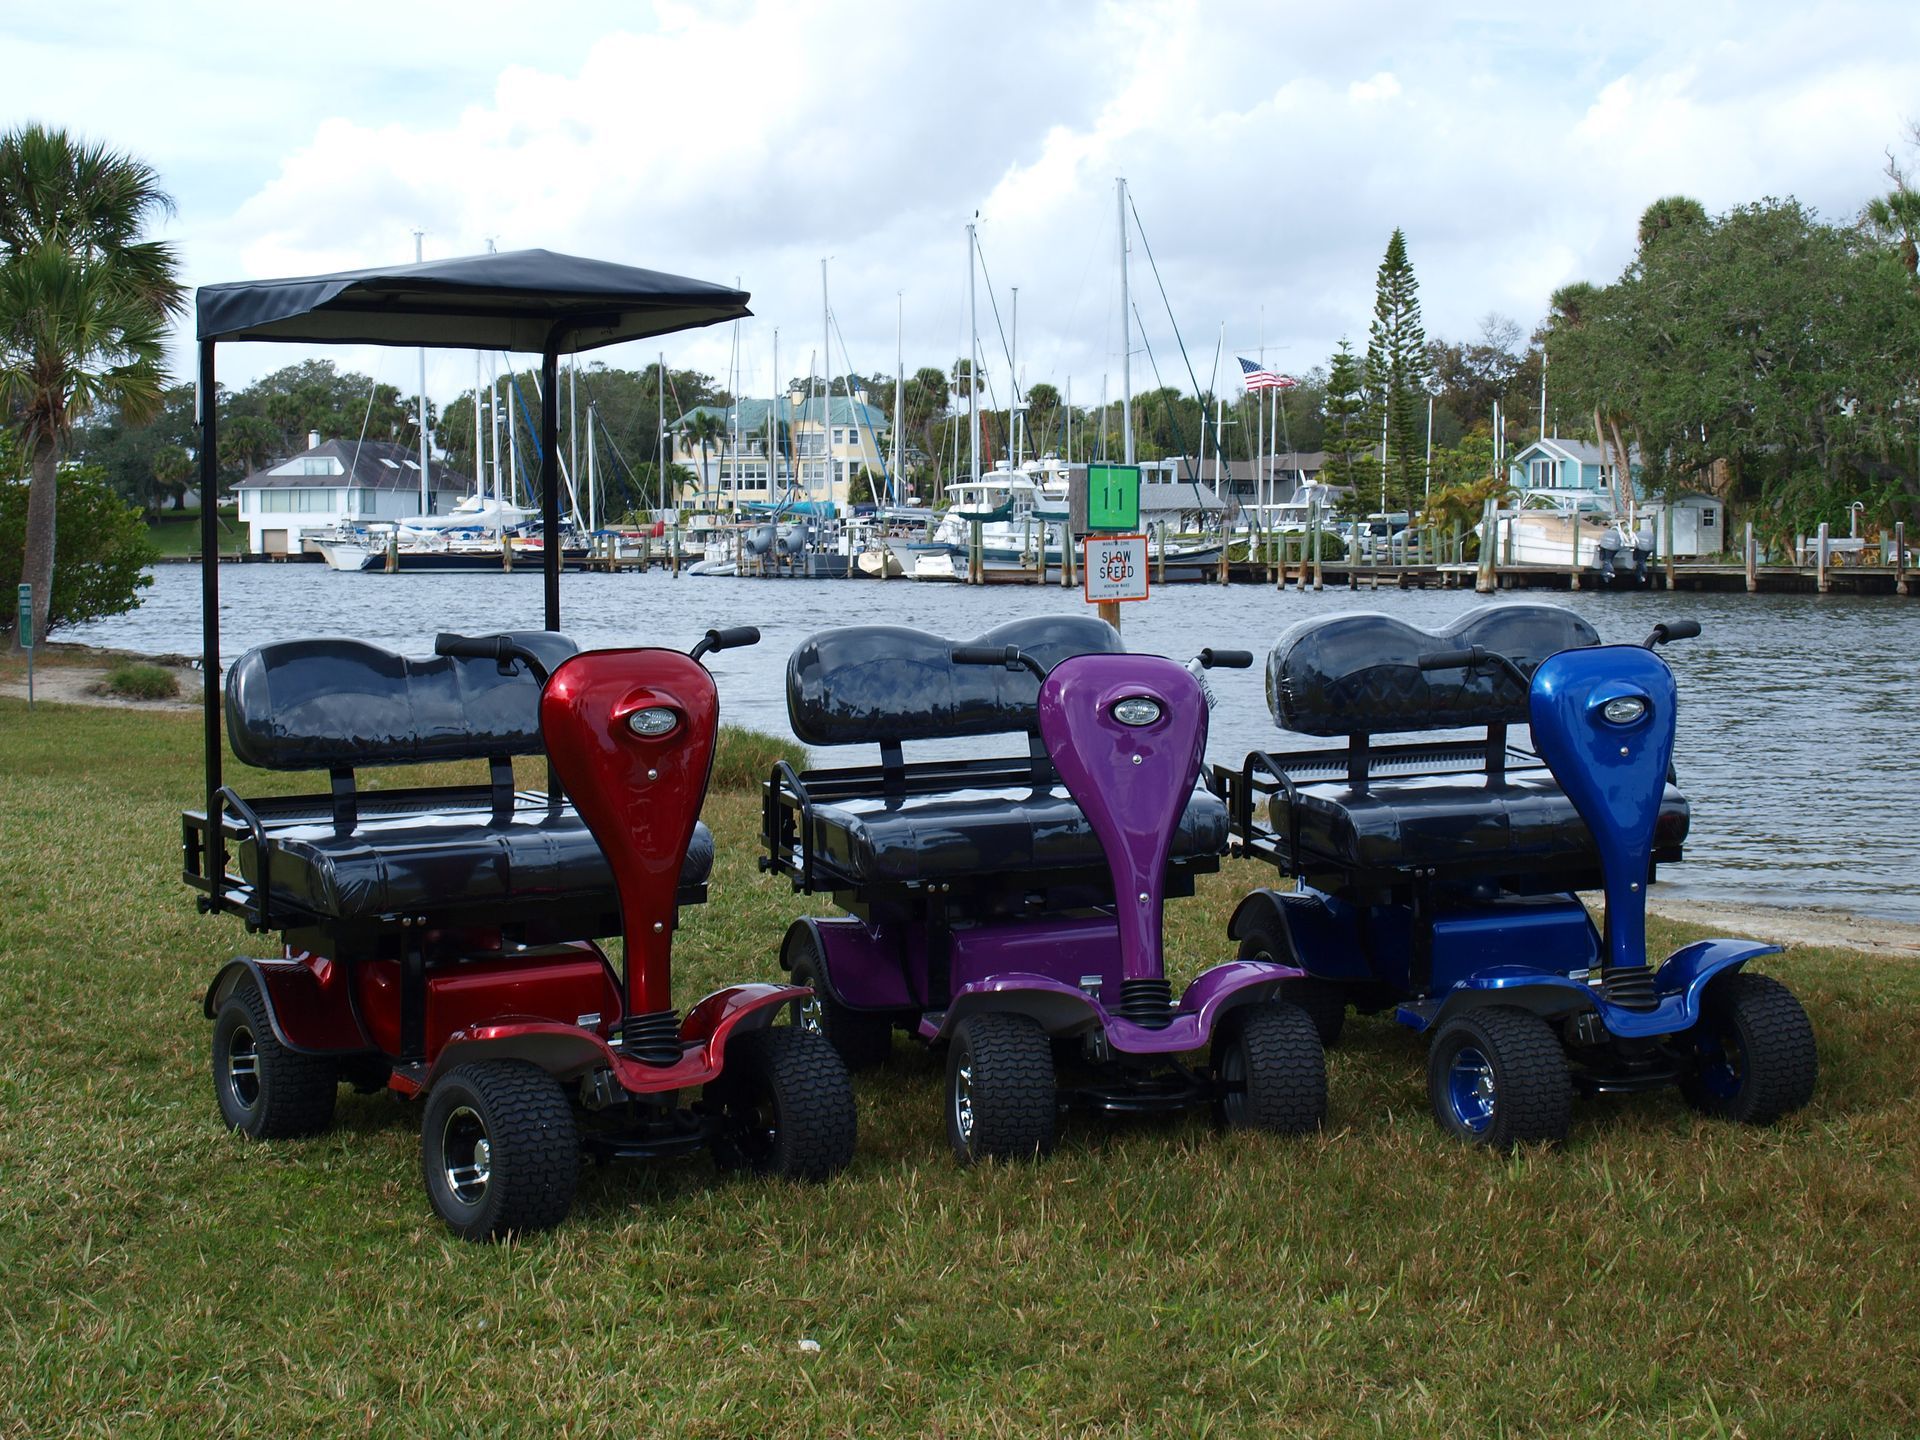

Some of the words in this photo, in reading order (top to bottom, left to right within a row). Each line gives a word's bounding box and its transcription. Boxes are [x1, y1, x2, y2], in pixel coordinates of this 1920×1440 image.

[1103, 487, 1123, 511] 11
[1102, 550, 1131, 564] SLOW
[1099, 565, 1134, 579] SPEED
